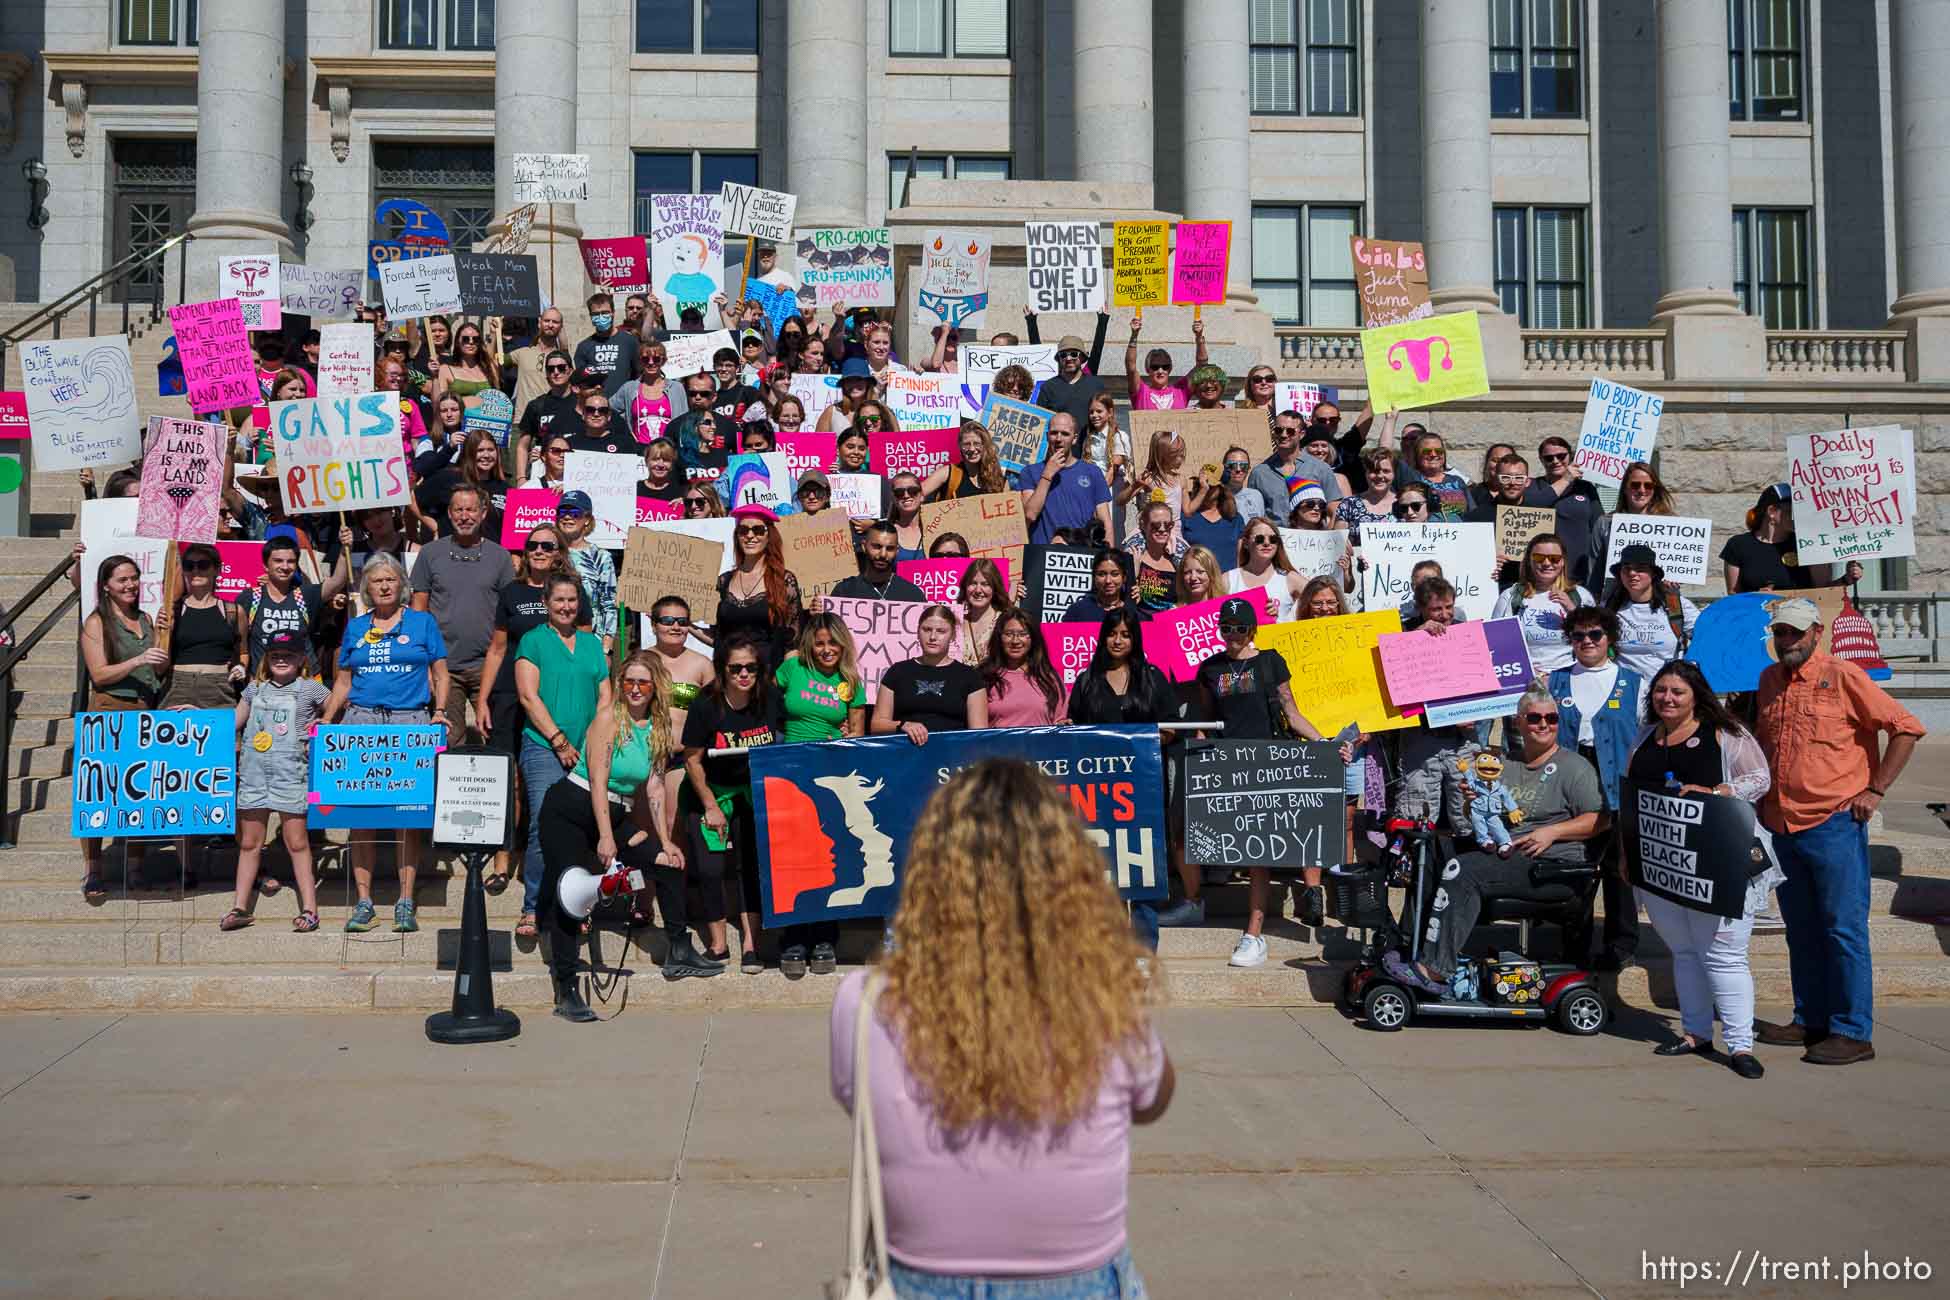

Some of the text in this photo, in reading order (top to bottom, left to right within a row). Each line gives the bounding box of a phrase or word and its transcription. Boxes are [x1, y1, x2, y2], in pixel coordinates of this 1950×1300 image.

[692, 195, 712, 208] MY
[723, 184, 753, 232] MY
[753, 199, 786, 215] CHOICE
[749, 222, 783, 240] VOICE
[816, 230, 889, 247] PRO-CHOICE
[1027, 225, 1100, 245] WOMEN
[1118, 237, 1152, 247] MEN GOT
[459, 257, 528, 272] Weak Men
[607, 256, 636, 268] OUR
[1030, 247, 1096, 267] DON'T
[384, 264, 416, 284] Forced
[1029, 267, 1098, 289] OWE U
[1117, 269, 1143, 278] ABORTION
[1135, 276, 1143, 284] IN
[309, 284, 337, 296] NOW
[472, 274, 516, 293] FEAR
[1116, 283, 1148, 295] COUNTRY
[236, 289, 265, 297] UTERUS
[1038, 289, 1092, 311] SHIT
[1130, 291, 1158, 301] CLUBS
[461, 293, 530, 312] Strong Women
[32, 345, 51, 357] THE
[595, 345, 619, 353] BANS
[595, 352, 618, 362] OFF
[25, 355, 81, 371] BLUE WAVE
[969, 352, 1000, 369] ROE
[888, 372, 939, 392] FEMINISM
[191, 380, 254, 404] LAND BACK
[906, 393, 960, 408] DIVERSITY
[1592, 380, 1610, 401] NO
[1612, 387, 1643, 409] BODY
[279, 394, 394, 440] GAYS
[998, 406, 1041, 432] KEEP
[1605, 405, 1643, 430] FREE
[51, 431, 84, 446] BLUE
[173, 425, 204, 438] THIS
[989, 422, 1040, 448] ABORTION
[1600, 422, 1635, 445] WHEN
[71, 439, 123, 454] NO MATTER
[167, 441, 204, 455] LAND
[886, 442, 926, 457] BANS
[1583, 433, 1646, 462] OTHERS ARE
[1811, 431, 1874, 459] Bodily
[161, 454, 209, 470] IS MY
[788, 456, 821, 467] OUR
[885, 453, 950, 466] OFF OUR
[164, 468, 208, 484] LAND.
[686, 472, 720, 483] PRO
[1792, 457, 1904, 486] Autonomy is
[287, 456, 402, 508] RIGHTS
[1793, 484, 1869, 511] a HUMAN
[980, 498, 1018, 519] LIE
[1502, 508, 1552, 521] Abortion
[1832, 489, 1903, 528] RIGHT!
[1368, 528, 1457, 548] Human Rights
[1616, 522, 1706, 539] ABORTION
[1799, 539, 1814, 548] Do
[1820, 534, 1829, 546] I
[1867, 528, 1895, 540] Look
[657, 540, 692, 562] NOW
[1384, 543, 1436, 556] Are Not
[1615, 538, 1704, 553] IS CARE
[633, 552, 665, 569] HAVE
[1659, 553, 1703, 564] CARE IS
[913, 571, 958, 586] BANS
[1666, 565, 1701, 576] RIGHT
[1047, 574, 1089, 588] WITH
[262, 607, 299, 621] BANS
[262, 620, 300, 637] OFF
[1176, 612, 1221, 638] BANS
[369, 648, 391, 656] ROE
[859, 641, 921, 663] MY
[1180, 632, 1212, 656] OFF
[369, 656, 391, 664] ROE
[385, 664, 413, 673] VOTE
[81, 714, 124, 755] MY
[741, 724, 770, 737] WOMEN'S
[325, 732, 440, 752] SUPREME COURT
[738, 731, 774, 749] MARCH
[361, 751, 407, 763] GIVETH
[1236, 747, 1257, 762] MY
[322, 755, 347, 774] NO!
[366, 765, 393, 779] AND
[1077, 755, 1136, 775] CITY
[79, 760, 232, 806] MY CHOICE
[336, 779, 416, 797] TAKETH AWAY
[449, 776, 472, 784] SOUTH
[1192, 771, 1251, 791] IT'S MY
[1206, 792, 1324, 814] KEEP YOUR BANS
[1639, 793, 1700, 820] STAND
[1234, 810, 1301, 833] OFF MY
[1641, 822, 1683, 845] WITH
[1221, 825, 1323, 867] BODY!
[1641, 843, 1693, 869] BLACK
[1642, 866, 1710, 900] WOMEN
